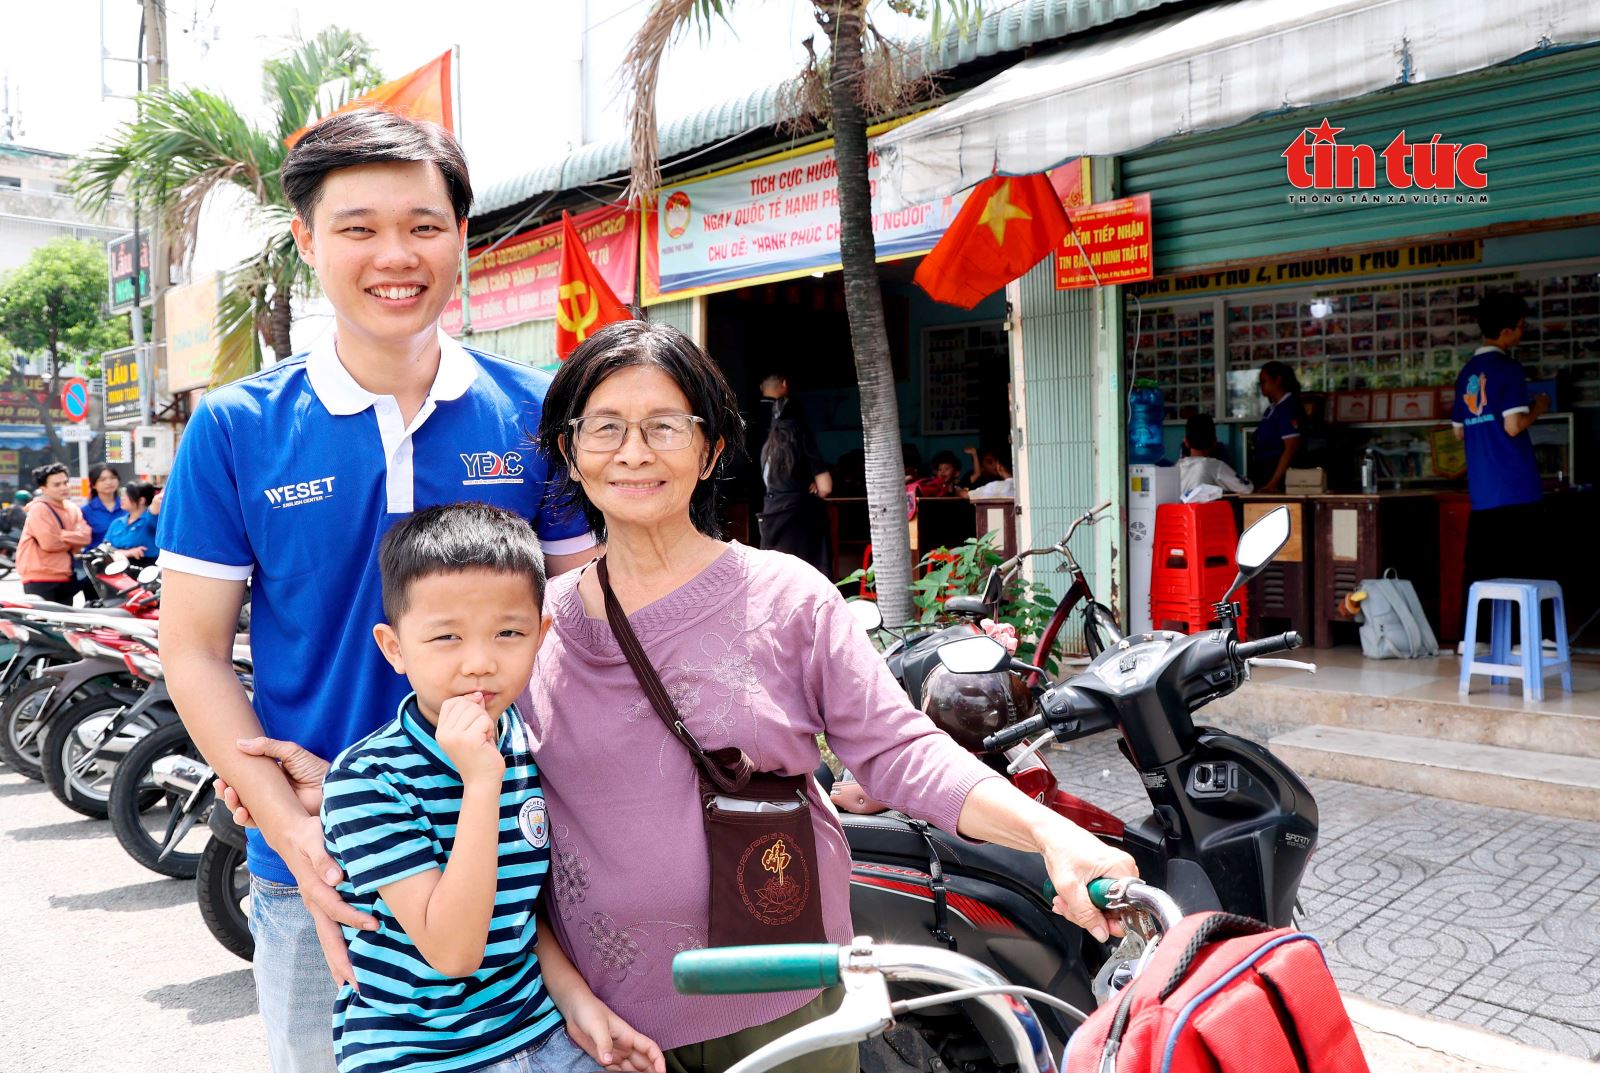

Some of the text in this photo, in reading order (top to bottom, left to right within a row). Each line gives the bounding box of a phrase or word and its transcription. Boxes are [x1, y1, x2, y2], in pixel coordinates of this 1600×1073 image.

[751, 155, 839, 196] TÍCH CỰC HƯỞN
[735, 199, 764, 227] QUỐC
[768, 194, 783, 219] TẾ
[1093, 223, 1115, 244] TIẾP
[1118, 220, 1144, 240] NHẬN
[264, 476, 336, 504] WESET
[1285, 833, 1311, 846] SPORTY
